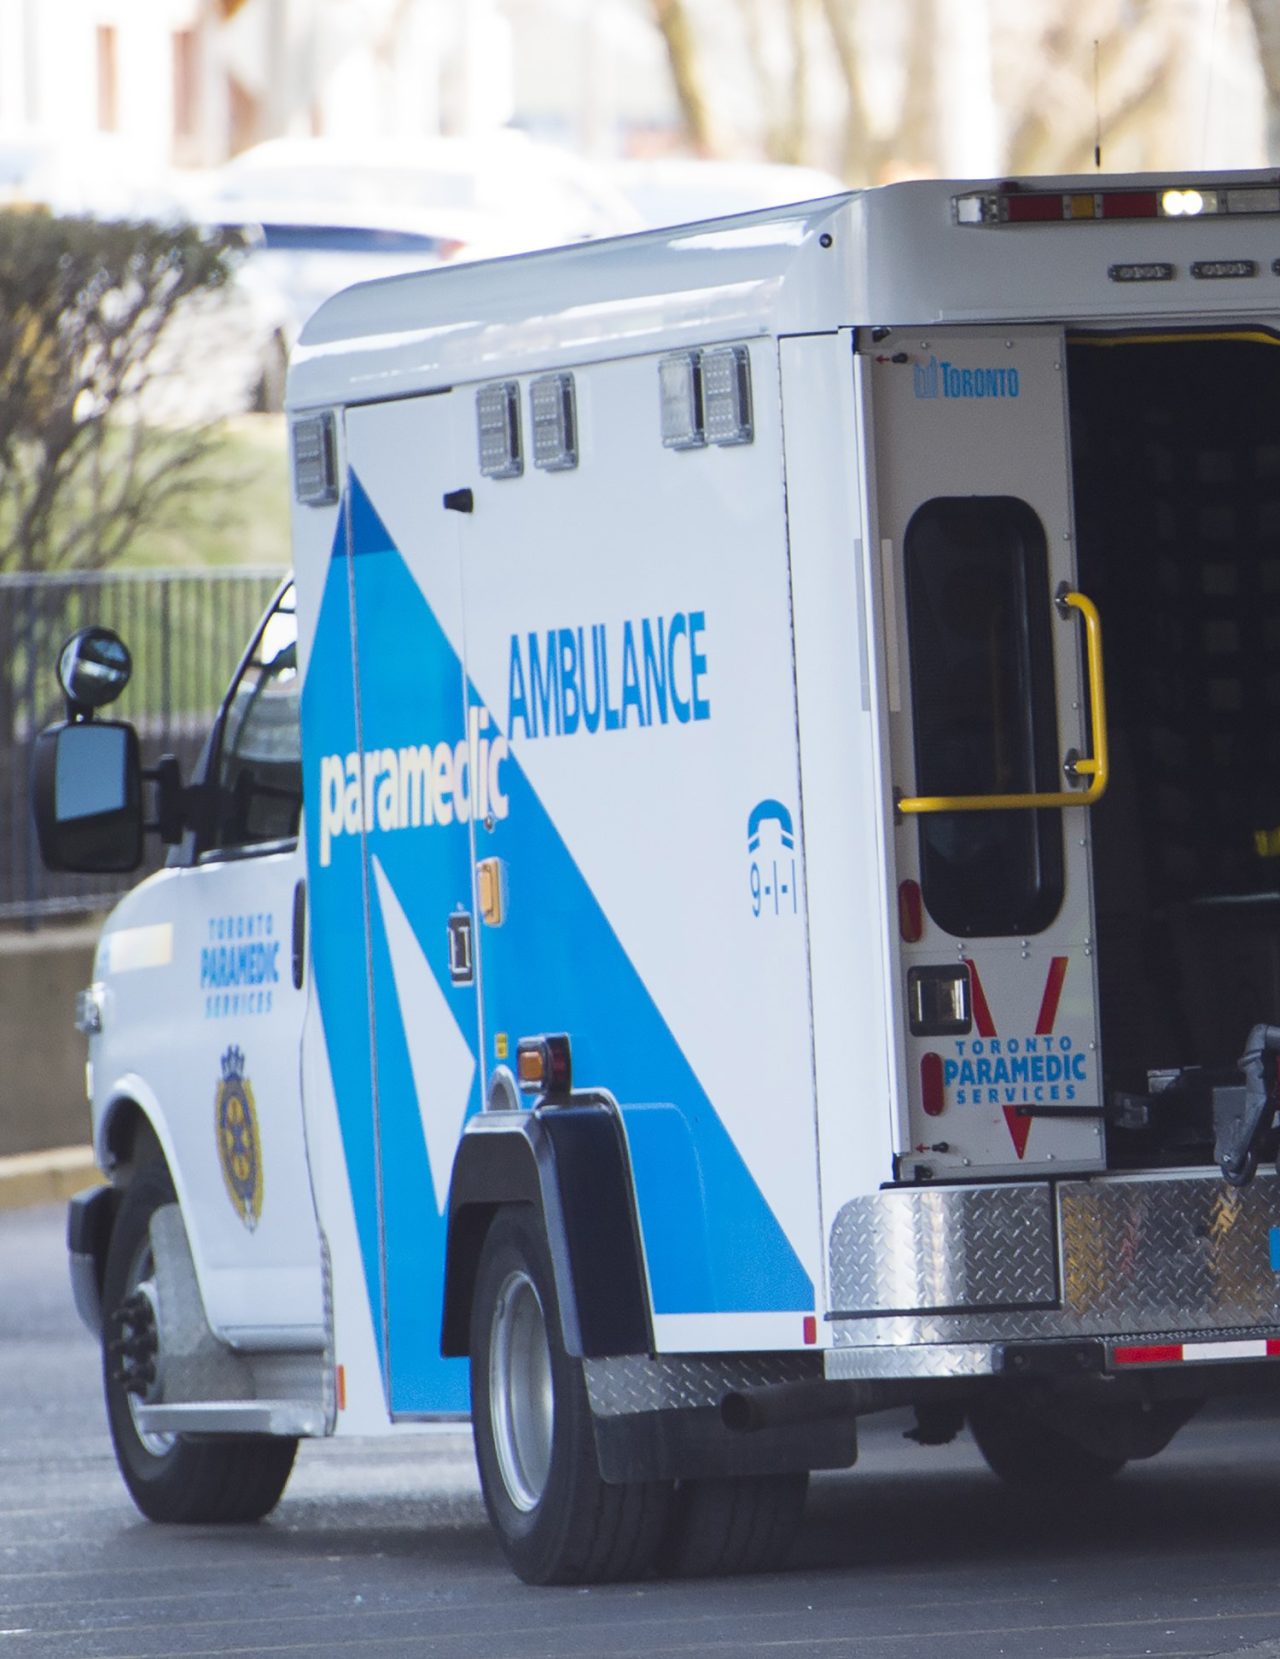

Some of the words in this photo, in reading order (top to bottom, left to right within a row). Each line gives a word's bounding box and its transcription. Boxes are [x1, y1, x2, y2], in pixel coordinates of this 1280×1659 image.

[940, 362, 1019, 398] TORONTO
[508, 611, 711, 739] AMBULANCE
[319, 706, 510, 868] paramedic
[748, 861, 798, 918] 9-1-1
[208, 913, 274, 940] TORONTO
[201, 942, 280, 988] PARAMEDIC
[956, 1037, 1072, 1055] TORONTO
[945, 1054, 1086, 1087] PARAMEDIC
[957, 1085, 1075, 1104] SERVICES
